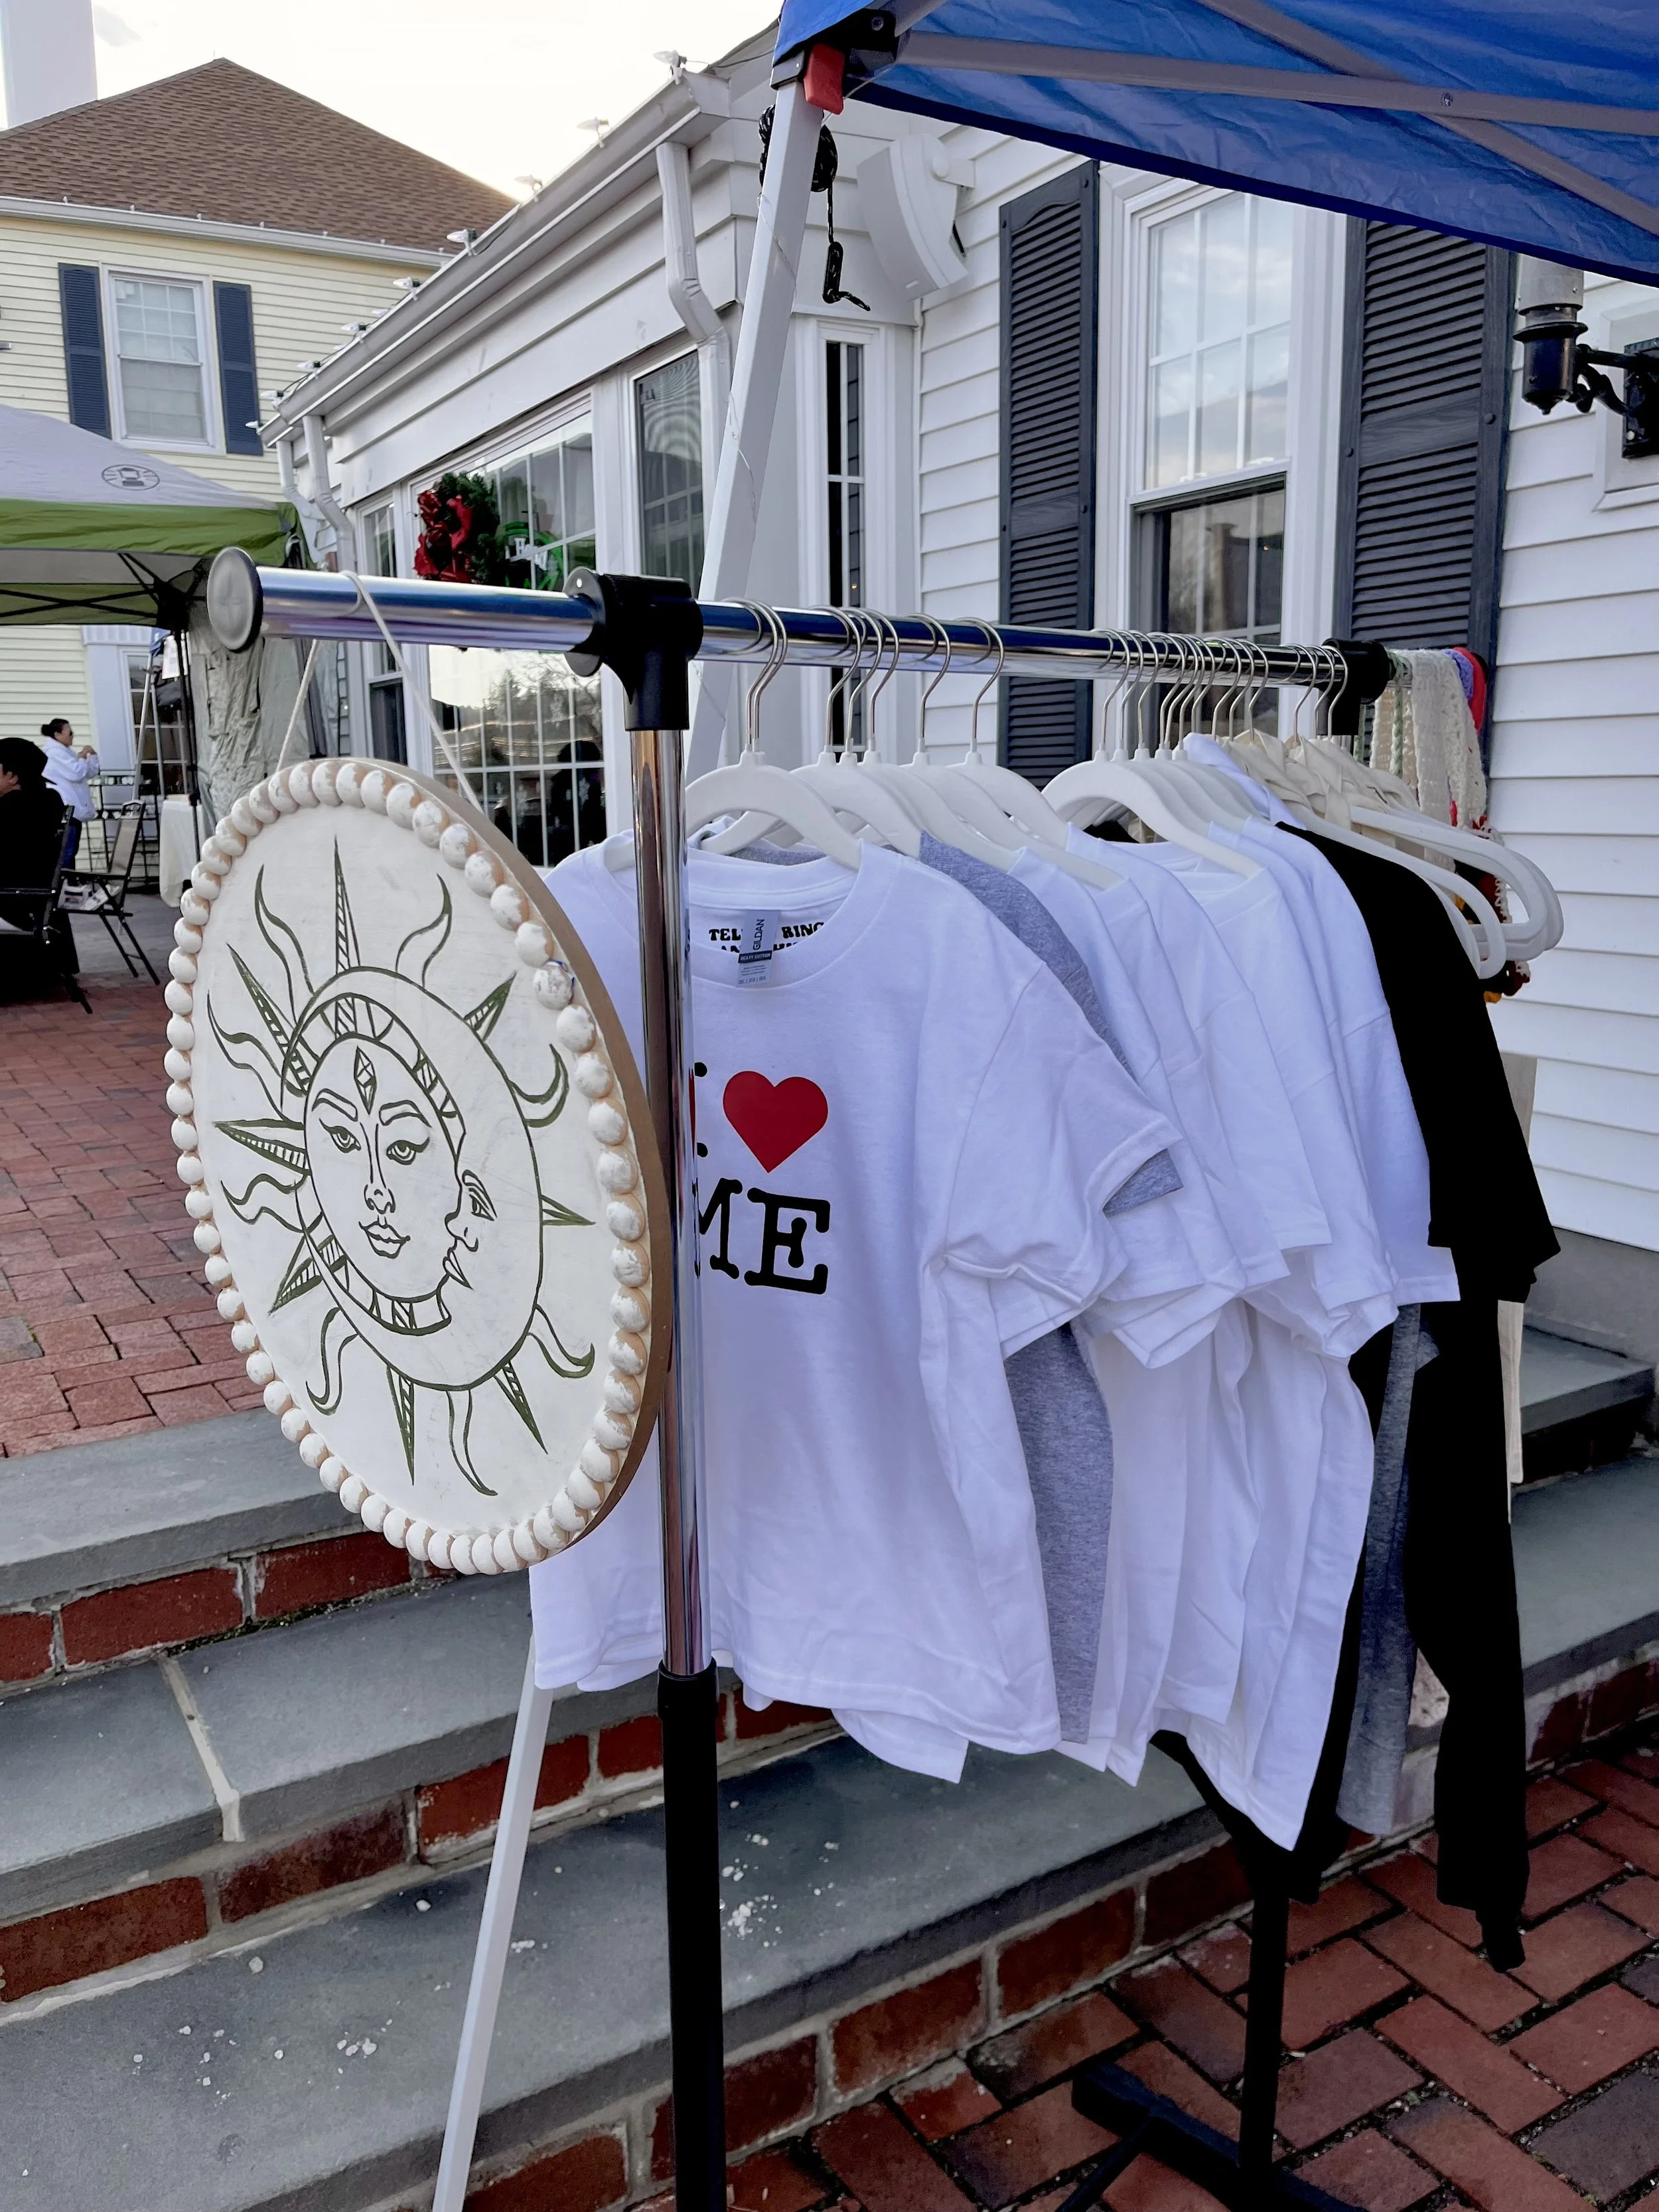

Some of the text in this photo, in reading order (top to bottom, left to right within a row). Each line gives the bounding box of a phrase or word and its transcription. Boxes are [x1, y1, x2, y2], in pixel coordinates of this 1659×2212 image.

[709, 928, 743, 941] TEL
[753, 918, 765, 950] GILDAN
[699, 1177, 831, 1295] ME
